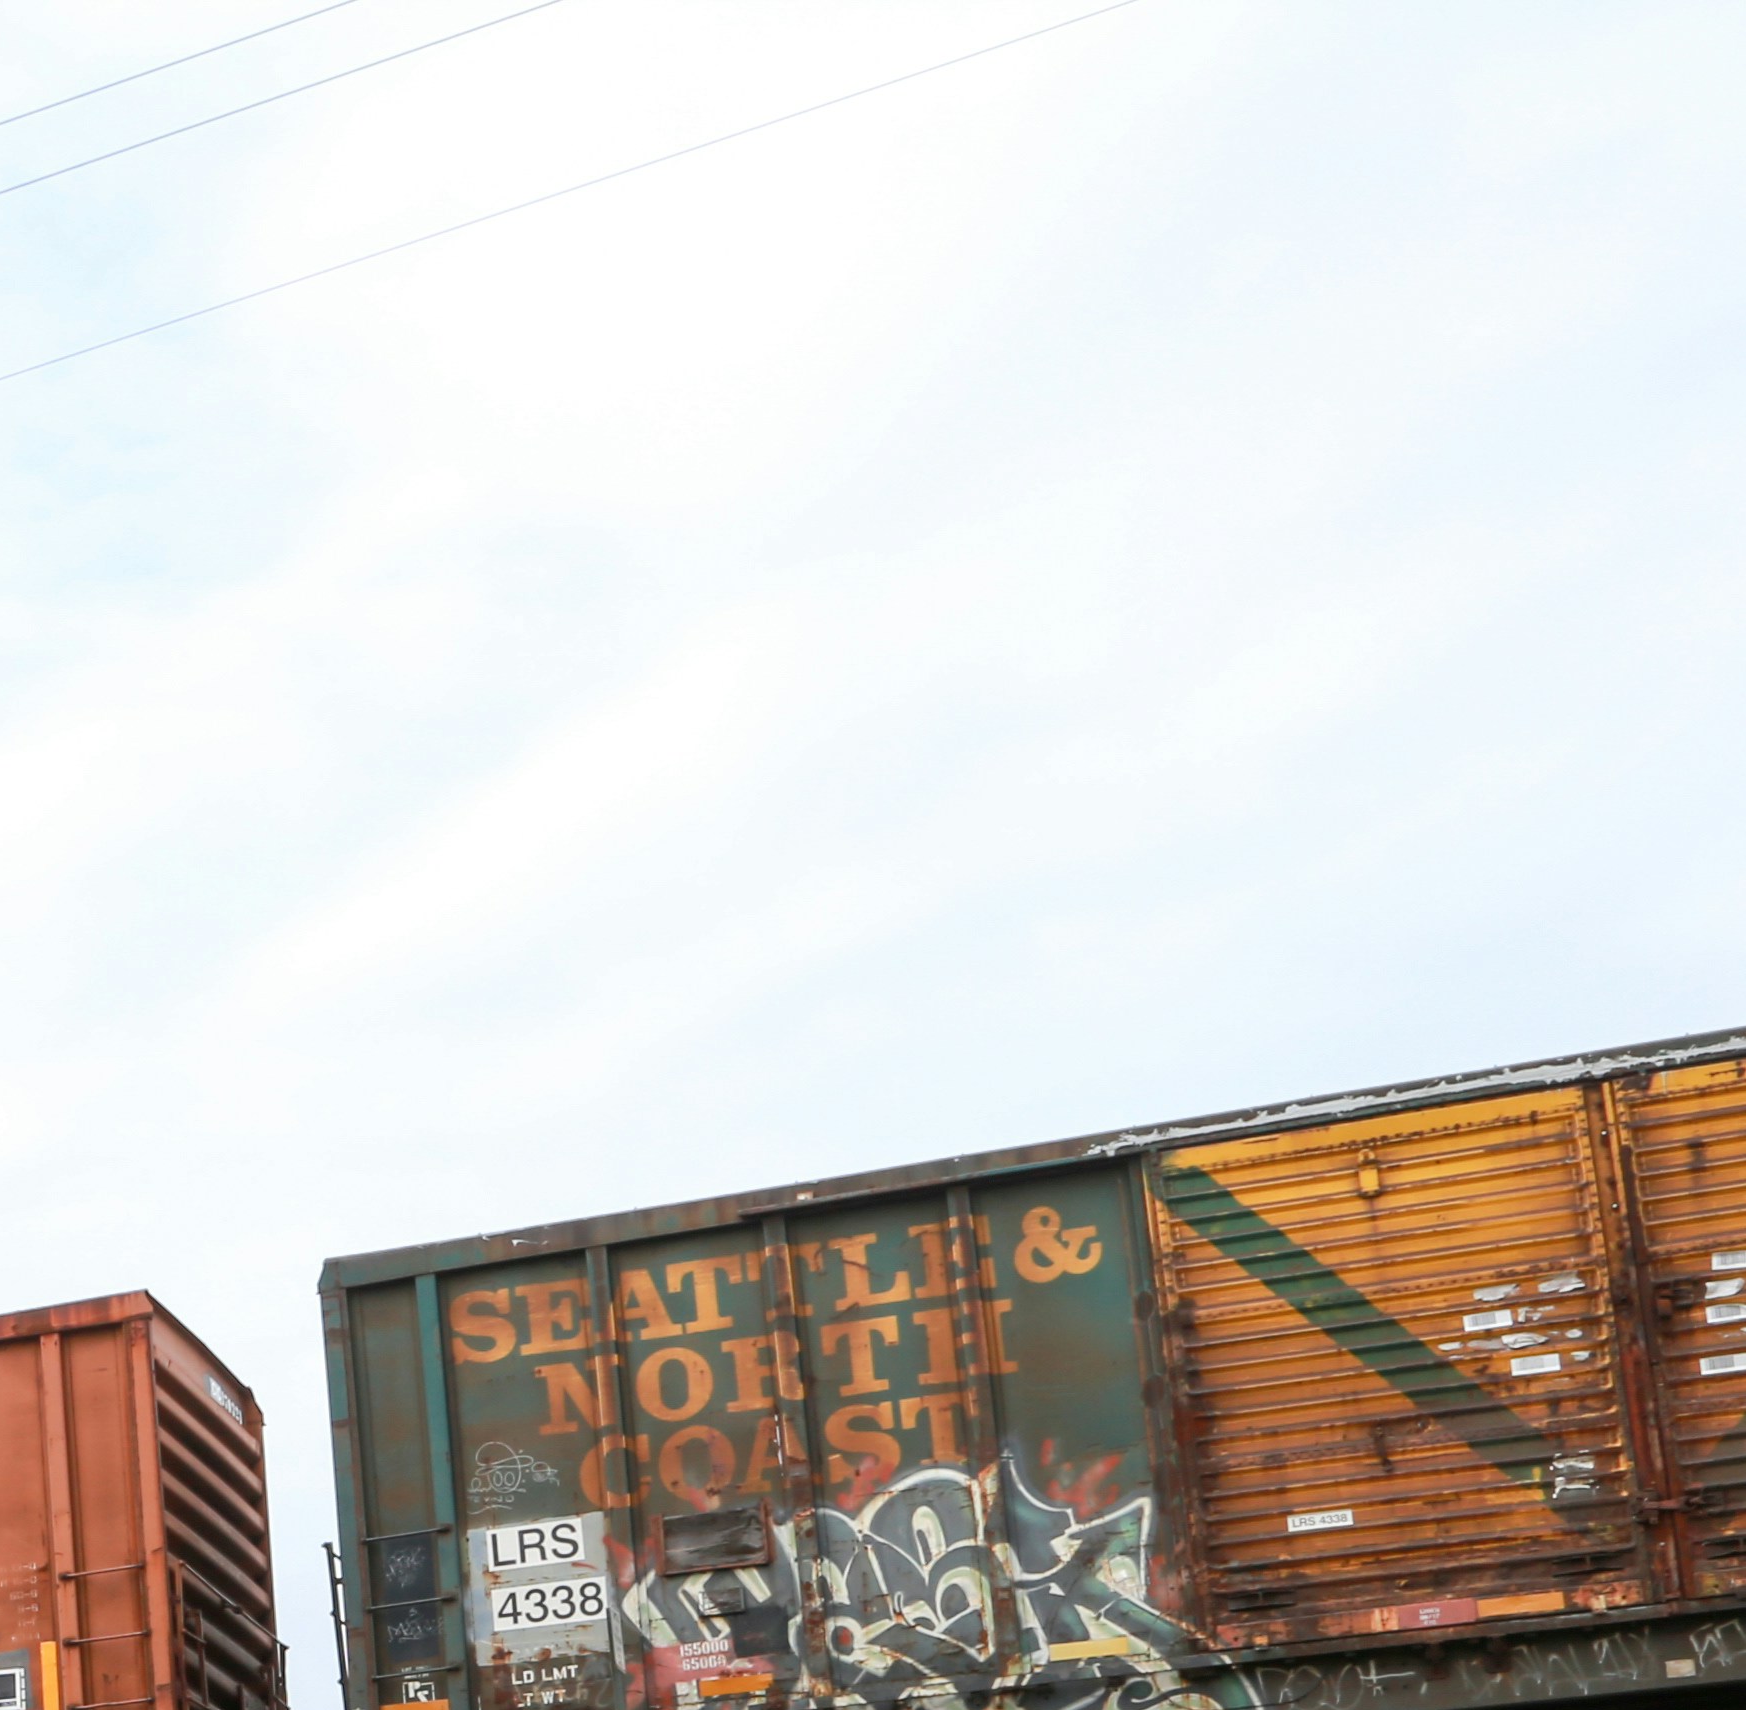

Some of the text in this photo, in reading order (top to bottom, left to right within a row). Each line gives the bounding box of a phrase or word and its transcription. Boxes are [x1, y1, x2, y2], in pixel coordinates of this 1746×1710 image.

[449, 1206, 1103, 1365] SEATTLE &
[533, 1299, 1019, 1436] NORTH
[579, 1392, 975, 1508] COAST
[1291, 1513, 1348, 1528] LRS 4338
[490, 1523, 580, 1568] LRS
[497, 1581, 604, 1625] 4338
[511, 1664, 579, 1685] LD LMT
[540, 1689, 566, 1705] WT
